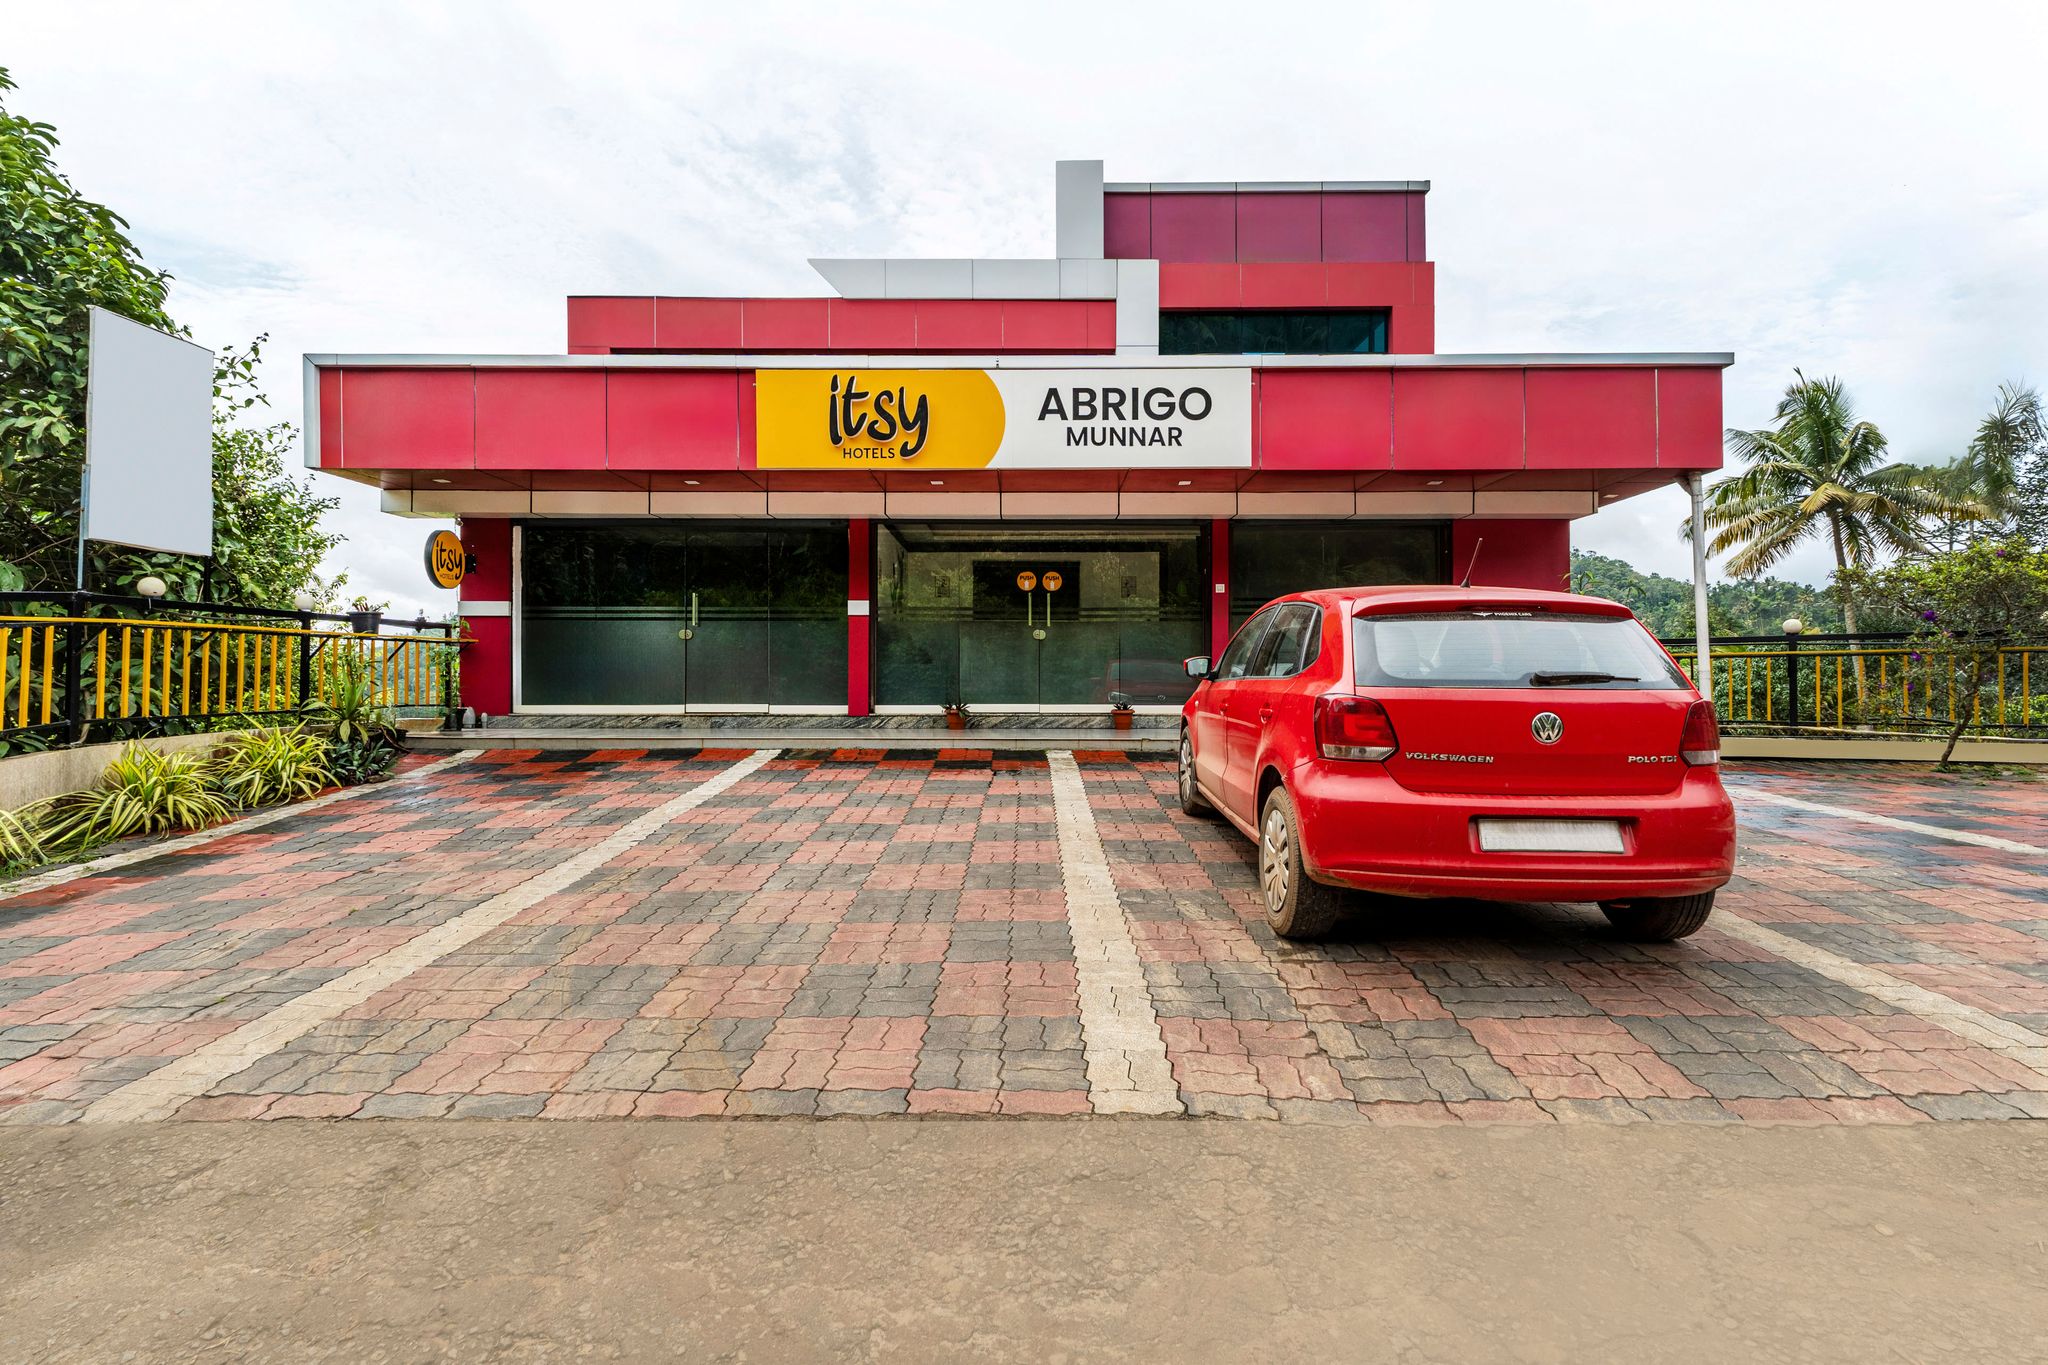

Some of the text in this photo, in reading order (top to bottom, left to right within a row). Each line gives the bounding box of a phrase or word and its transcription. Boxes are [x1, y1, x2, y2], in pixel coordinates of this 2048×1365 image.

[1038, 387, 1212, 421] ABRIGO
[829, 374, 928, 459] itsy
[1067, 426, 1183, 447] MUNNAR
[842, 447, 895, 460] HOTELS
[436, 540, 462, 580] itsy
[1405, 752, 1494, 763] VOLKSWAGEN
[1628, 755, 1658, 763] POLO
